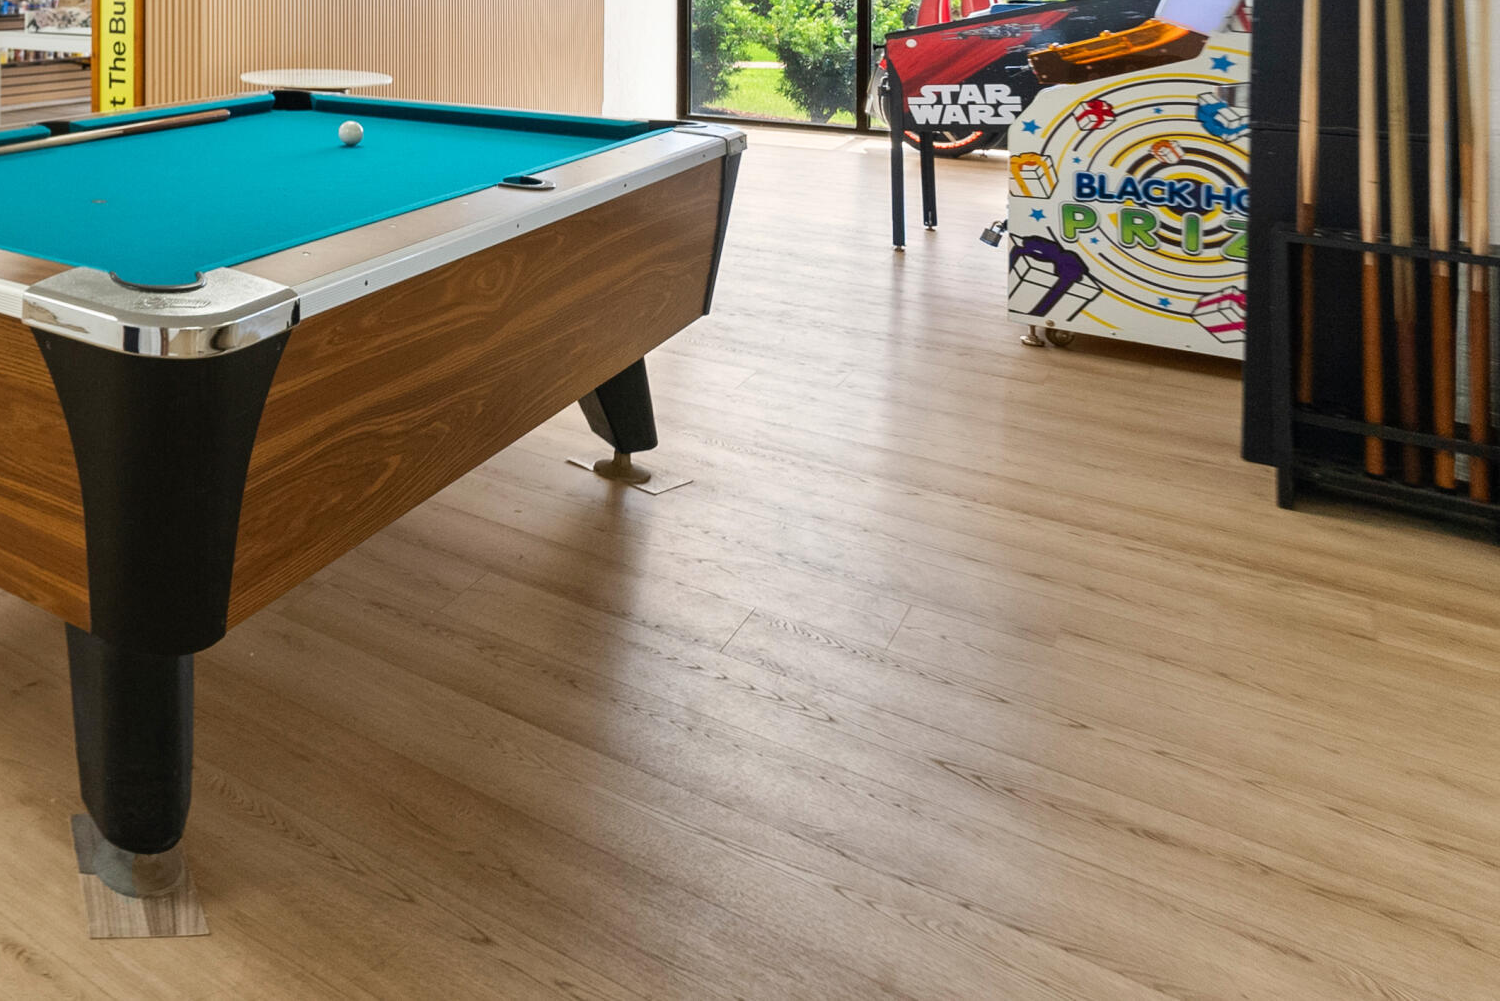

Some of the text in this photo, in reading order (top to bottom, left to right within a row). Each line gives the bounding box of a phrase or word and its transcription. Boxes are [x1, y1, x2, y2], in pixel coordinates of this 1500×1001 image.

[109, 41, 126, 89] The
[907, 83, 1021, 104] STAR
[908, 104, 1022, 125] WARS
[1075, 171, 1194, 208] BLACK
